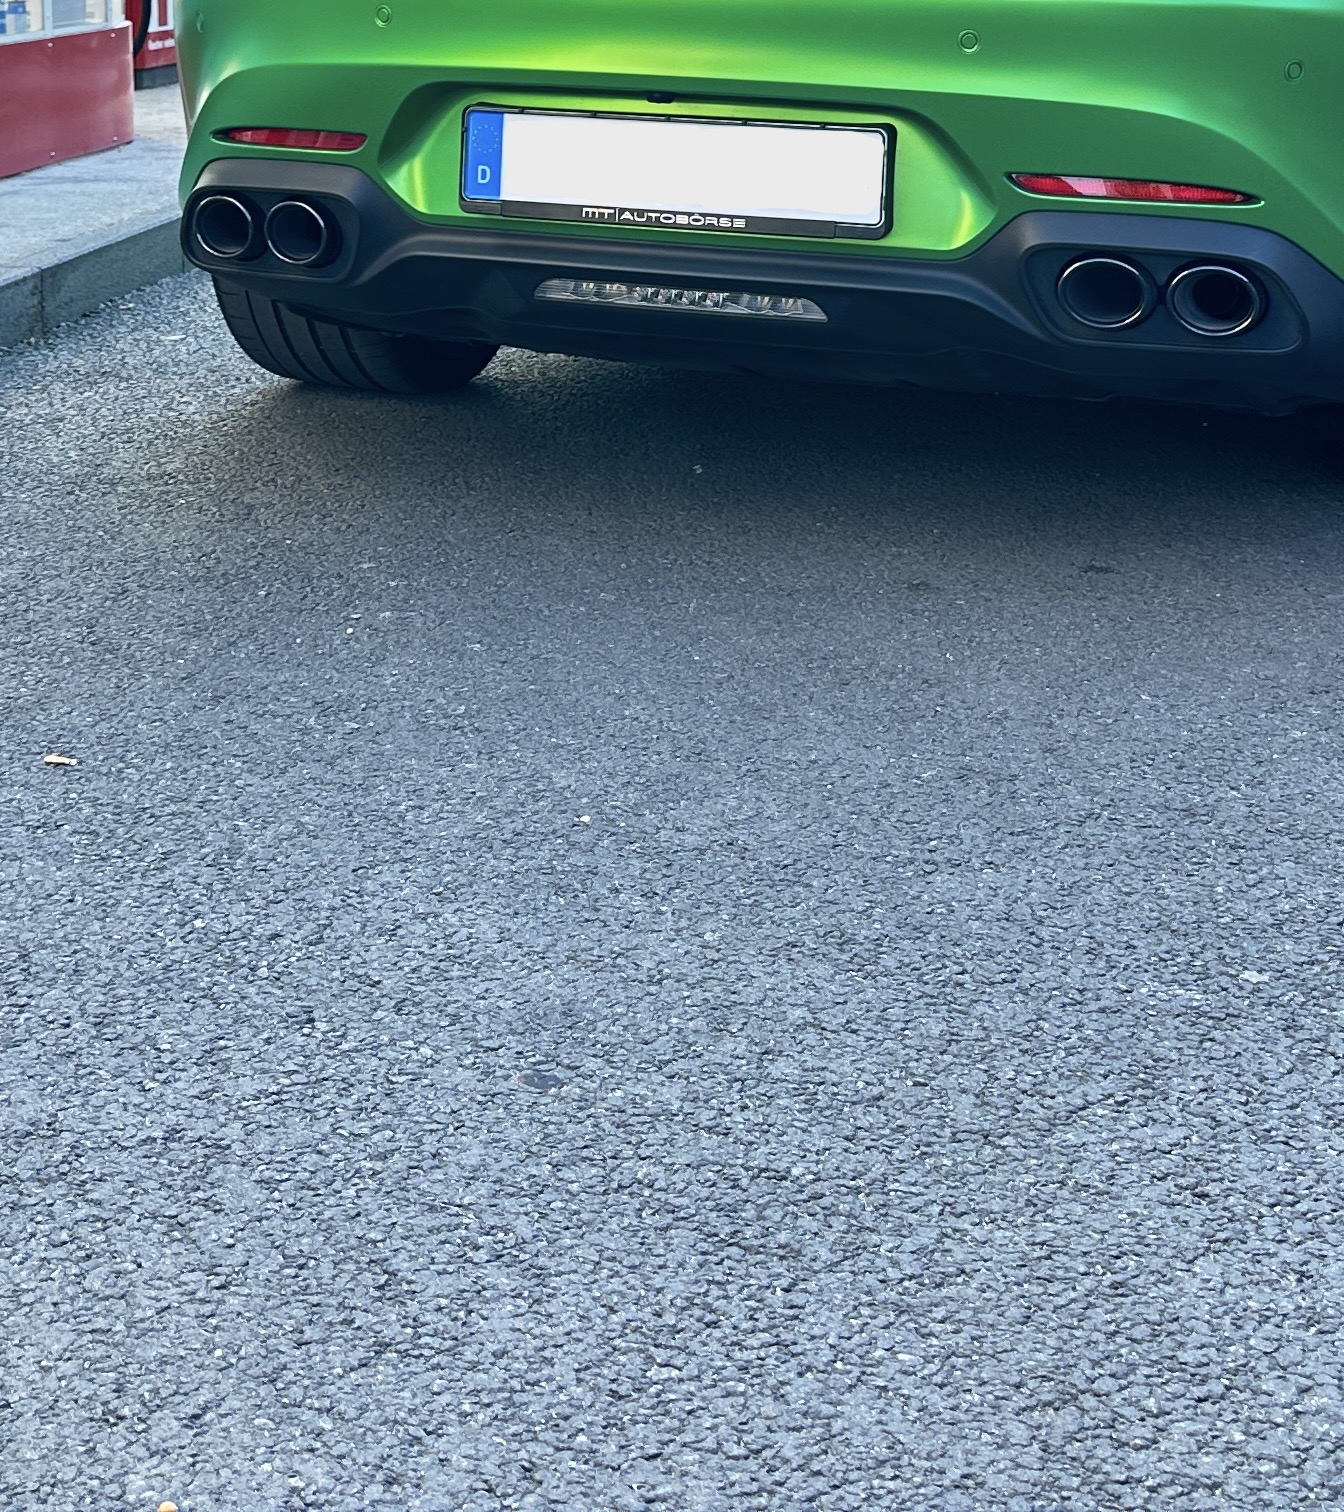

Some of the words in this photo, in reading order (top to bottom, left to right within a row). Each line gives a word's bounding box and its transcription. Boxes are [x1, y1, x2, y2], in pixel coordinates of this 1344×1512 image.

[477, 165, 491, 184] D
[582, 206, 615, 220] MT
[619, 210, 746, 228] AUTOBÖRSE
